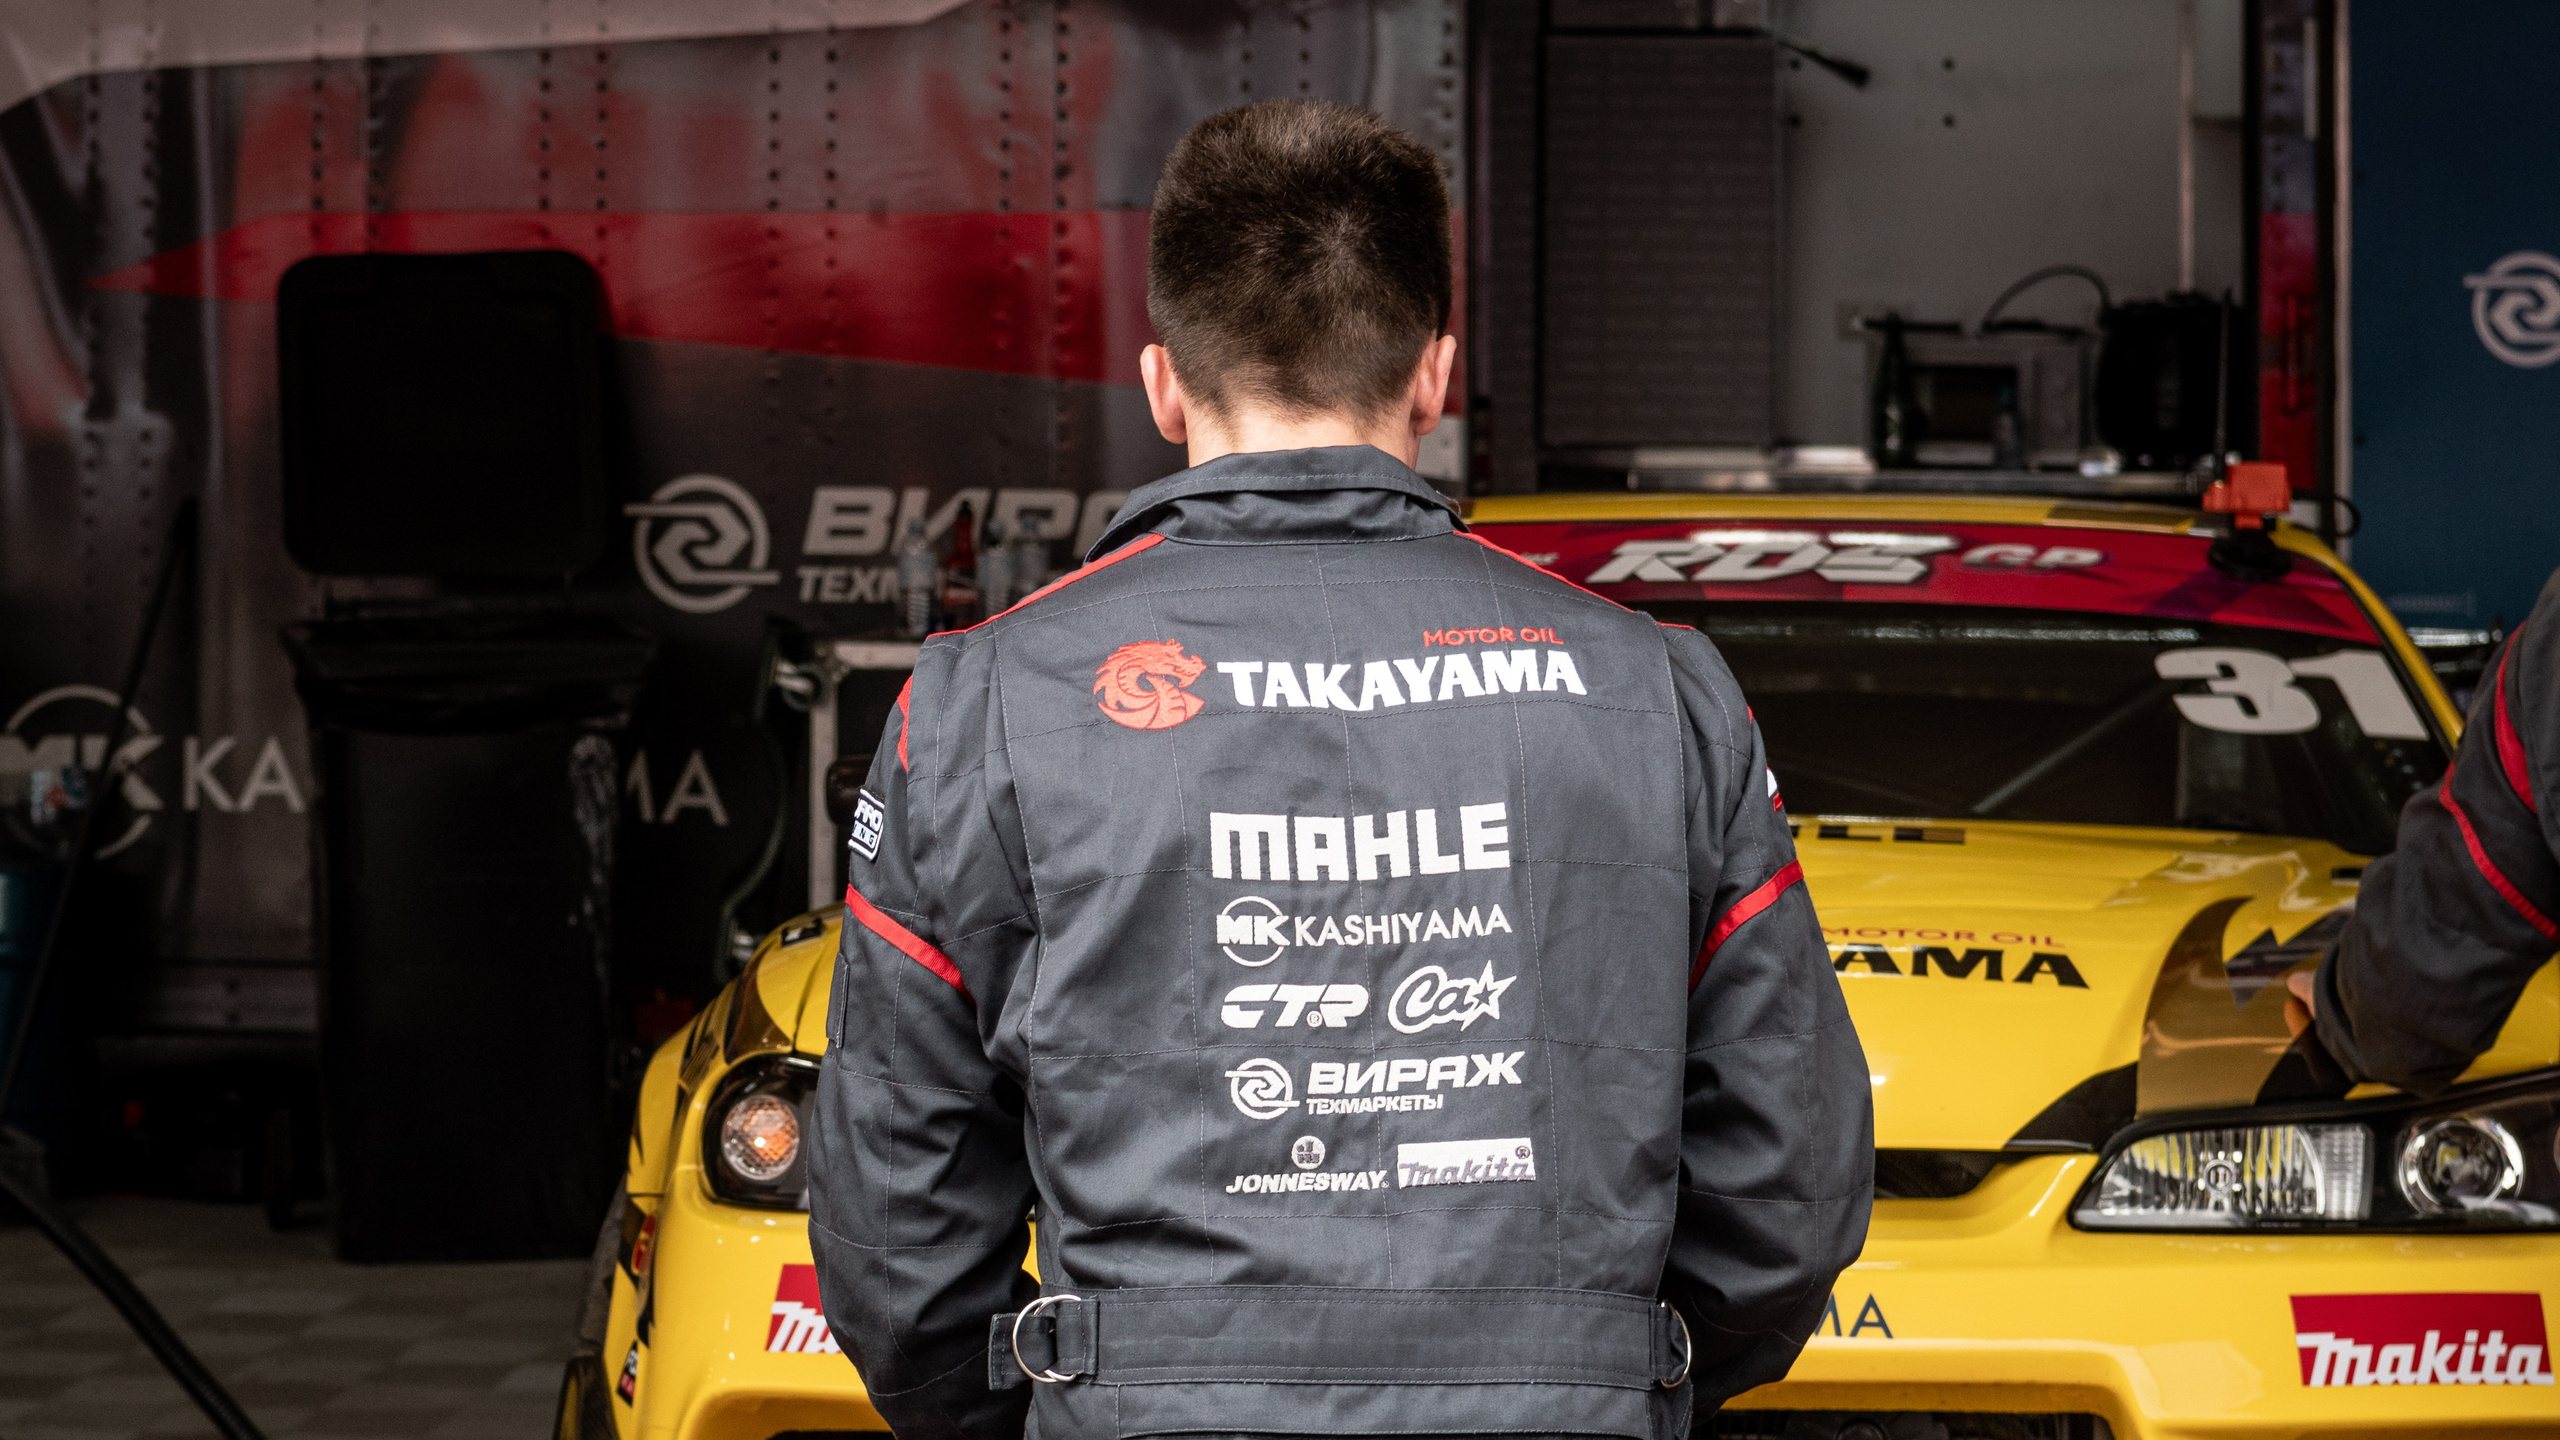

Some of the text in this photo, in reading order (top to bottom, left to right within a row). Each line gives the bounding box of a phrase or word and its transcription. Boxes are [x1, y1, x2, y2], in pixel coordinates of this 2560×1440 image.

[1961, 543, 2103, 569] GP
[1423, 626, 1565, 647] MOTOR OIL
[1217, 649, 1588, 711] TAKAYAMA
[2154, 646, 2430, 741] 31
[1210, 802, 1511, 881] MAHLE
[1216, 904, 1513, 947] MK KASHIYAMA
[1990, 931, 2066, 948] OIL
[1832, 942, 2090, 990] AMA
[1221, 984, 1369, 1028] CTR
[1307, 1051, 1525, 1095] ВИРАЖ
[1306, 1094, 1443, 1115] ТЕХМАРКЕТЫ
[1226, 1170, 1387, 1194] JONNESWAY
[2297, 1330, 2555, 1386] makita
